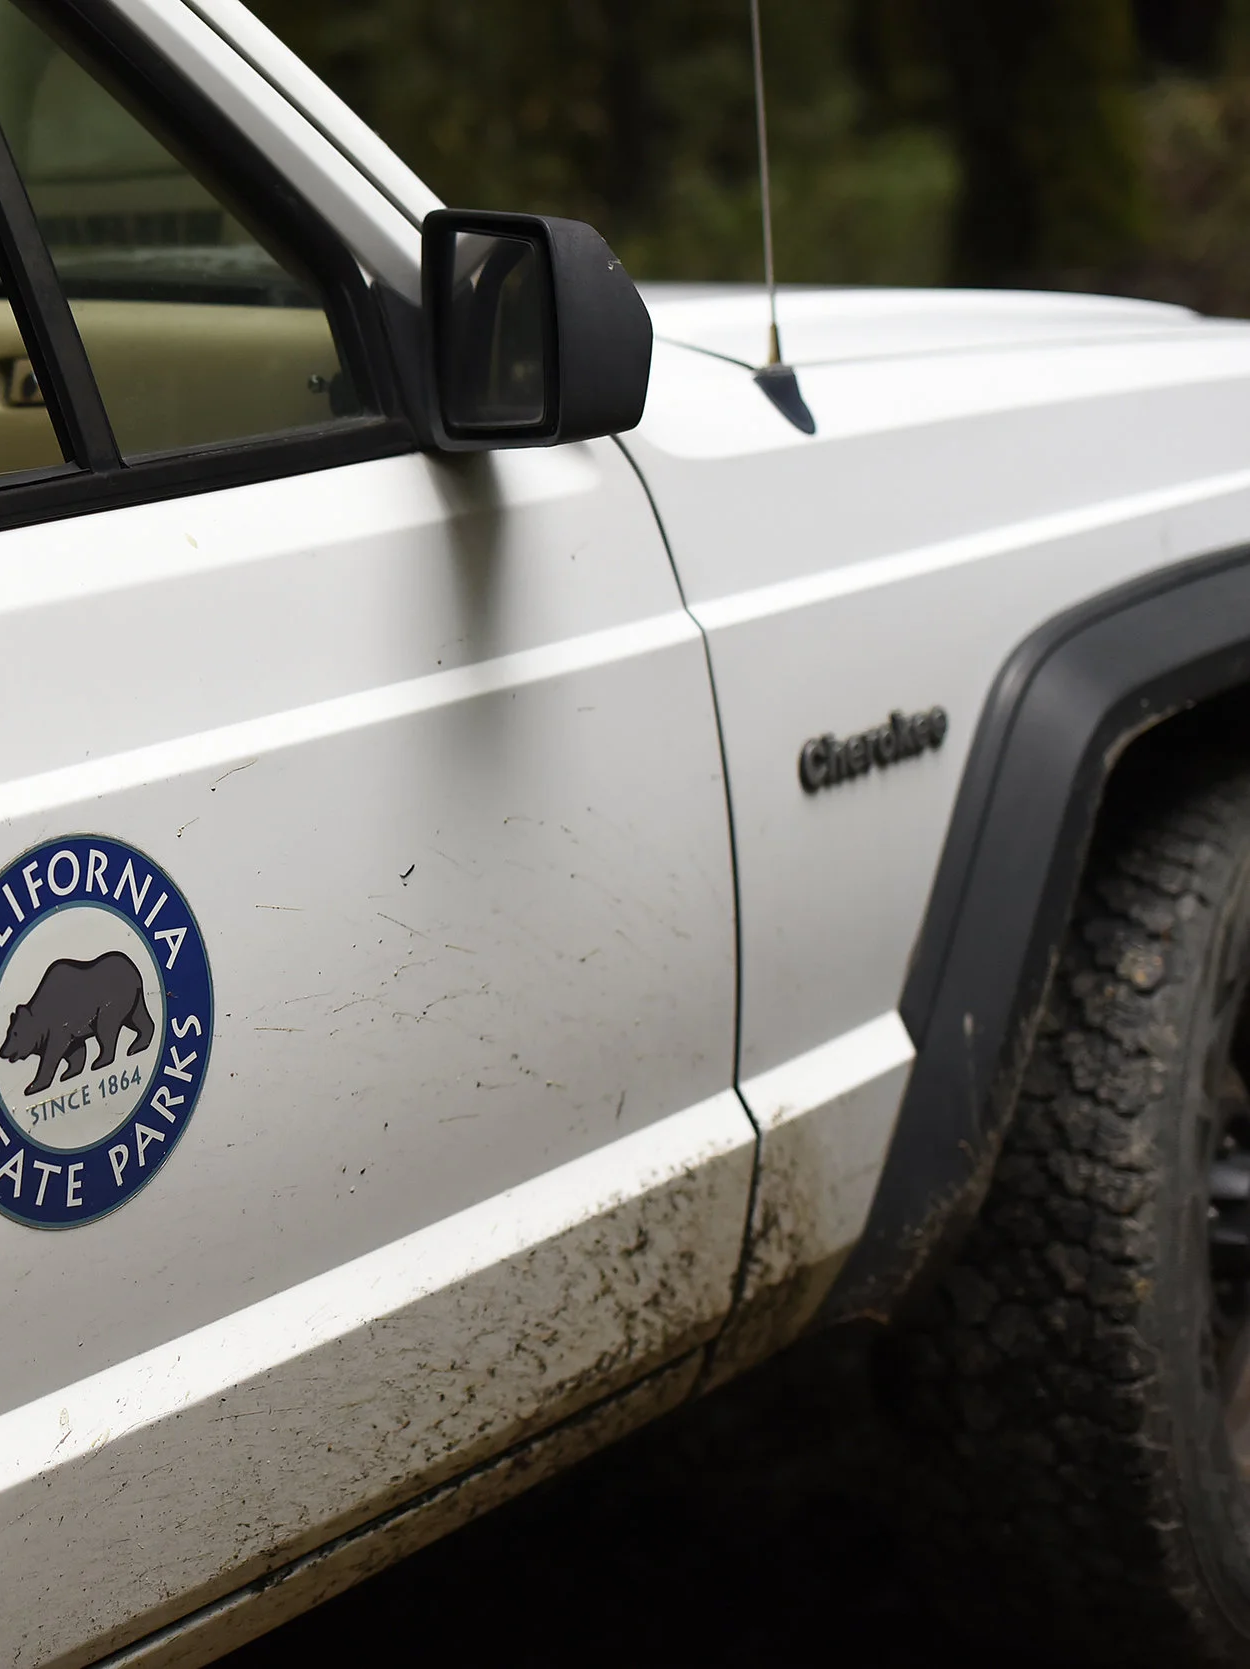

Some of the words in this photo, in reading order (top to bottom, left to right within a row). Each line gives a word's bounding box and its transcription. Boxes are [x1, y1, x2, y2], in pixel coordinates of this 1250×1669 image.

[798, 706, 949, 795] Cherokee
[30, 1085, 91, 1126] SINCE
[99, 1065, 142, 1100] 1864
[109, 1014, 202, 1187] PARKS
